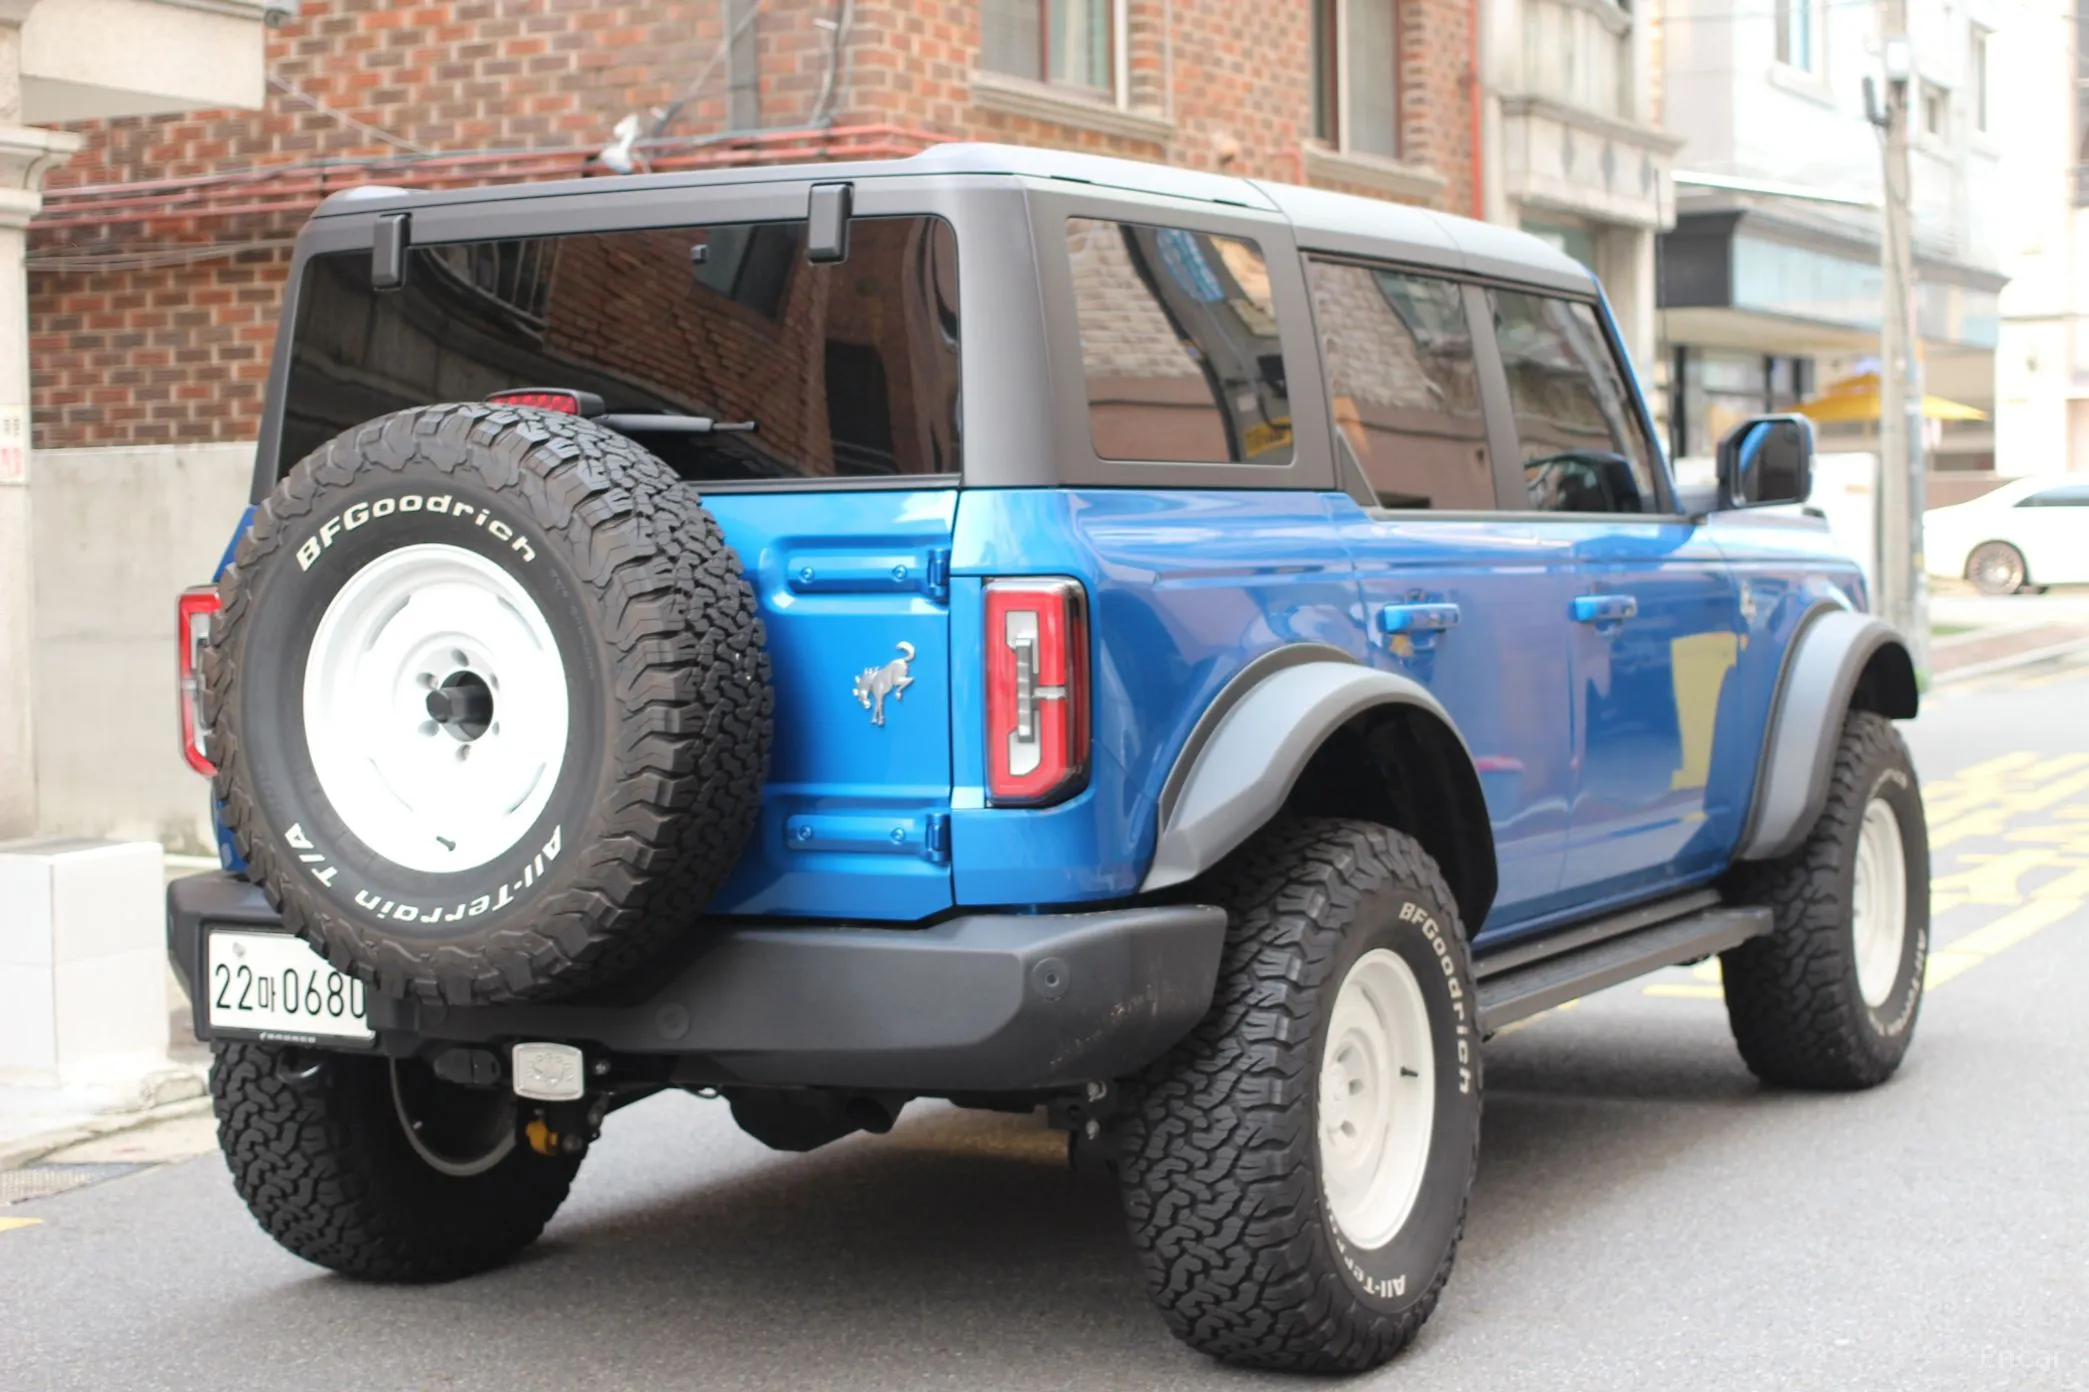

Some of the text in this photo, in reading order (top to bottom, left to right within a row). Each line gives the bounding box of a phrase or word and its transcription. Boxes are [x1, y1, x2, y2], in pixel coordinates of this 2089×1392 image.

[296, 494, 536, 572] BFGoodrich
[284, 822, 561, 923] All-Terrain T/A
[1399, 901, 1472, 1094] BFGoodrich
